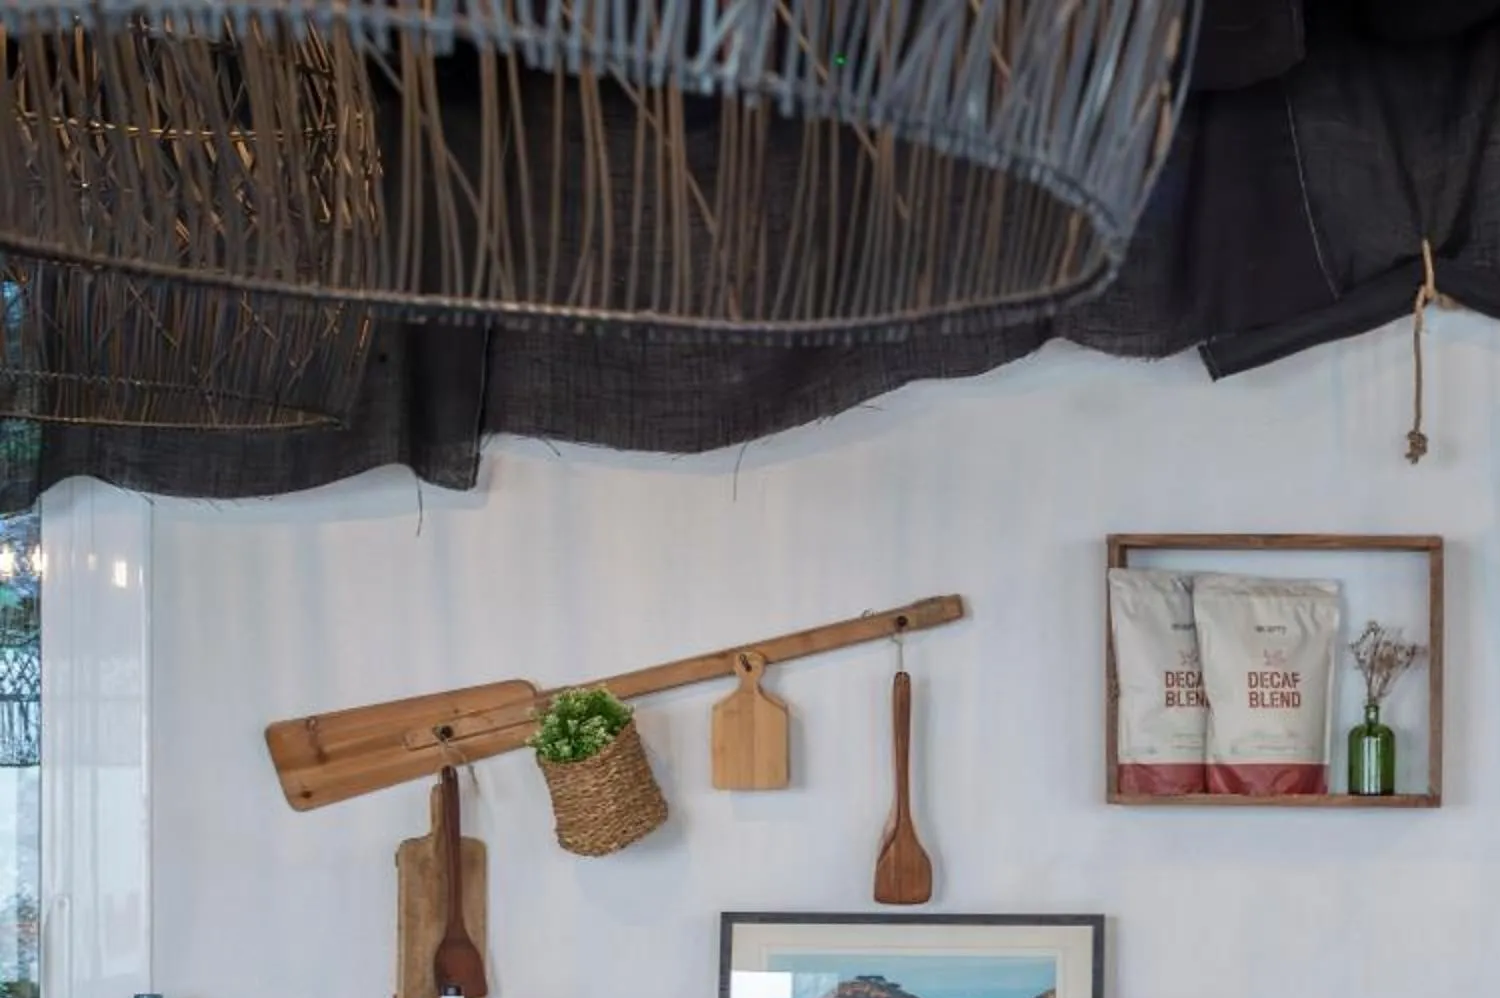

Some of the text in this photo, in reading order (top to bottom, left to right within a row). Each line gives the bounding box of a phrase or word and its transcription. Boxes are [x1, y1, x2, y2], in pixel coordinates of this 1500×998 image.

[1164, 671, 1205, 689] DECA
[1247, 671, 1301, 689] DECAF
[1164, 691, 1211, 708] BLEN
[1247, 691, 1302, 709] BLEND
